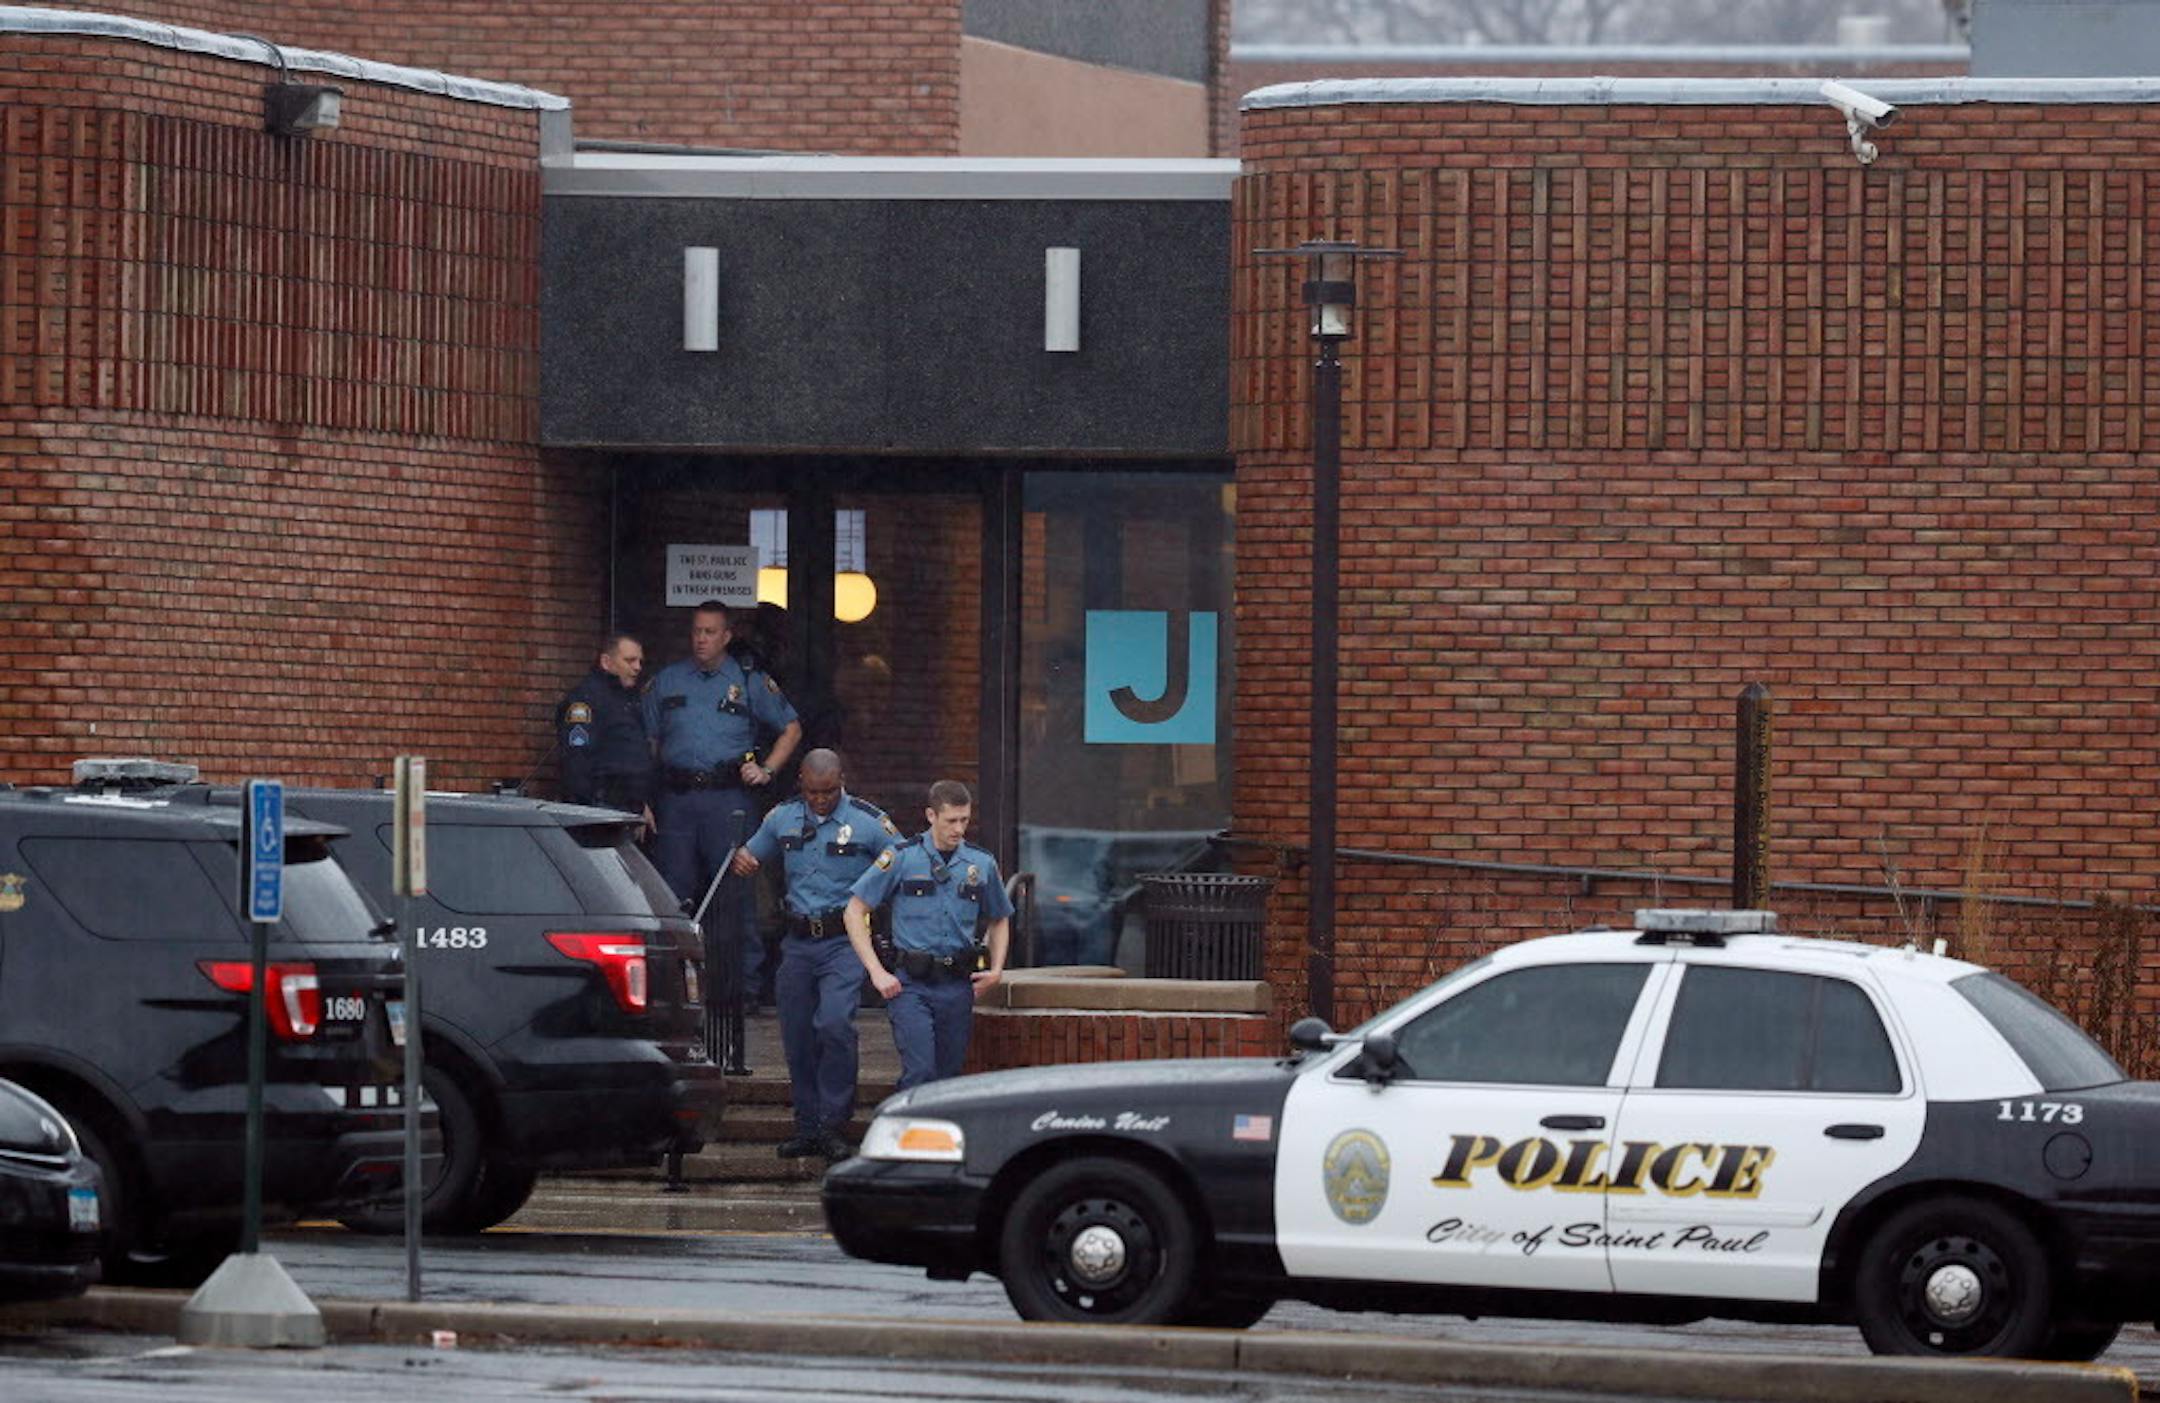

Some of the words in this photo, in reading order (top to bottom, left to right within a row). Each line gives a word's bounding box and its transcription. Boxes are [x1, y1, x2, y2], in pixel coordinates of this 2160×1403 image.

[679, 554, 695, 565] THE
[713, 570, 737, 580] GUNS
[672, 584, 682, 594] IN
[683, 584, 709, 595] THESE
[710, 585, 752, 595] PREMISES
[1109, 611, 1190, 724] J
[416, 927, 488, 949] 1483
[325, 997, 365, 1020] 1680
[1031, 1110, 1106, 1131] Canine
[1113, 1111, 1170, 1131] Unit
[1997, 1101, 2084, 1124] 1173
[1431, 1133, 1778, 1199] POLICE
[1511, 1225, 1553, 1256] of
[1558, 1223, 1665, 1250] Saint
[1672, 1225, 1770, 1253] Paul
